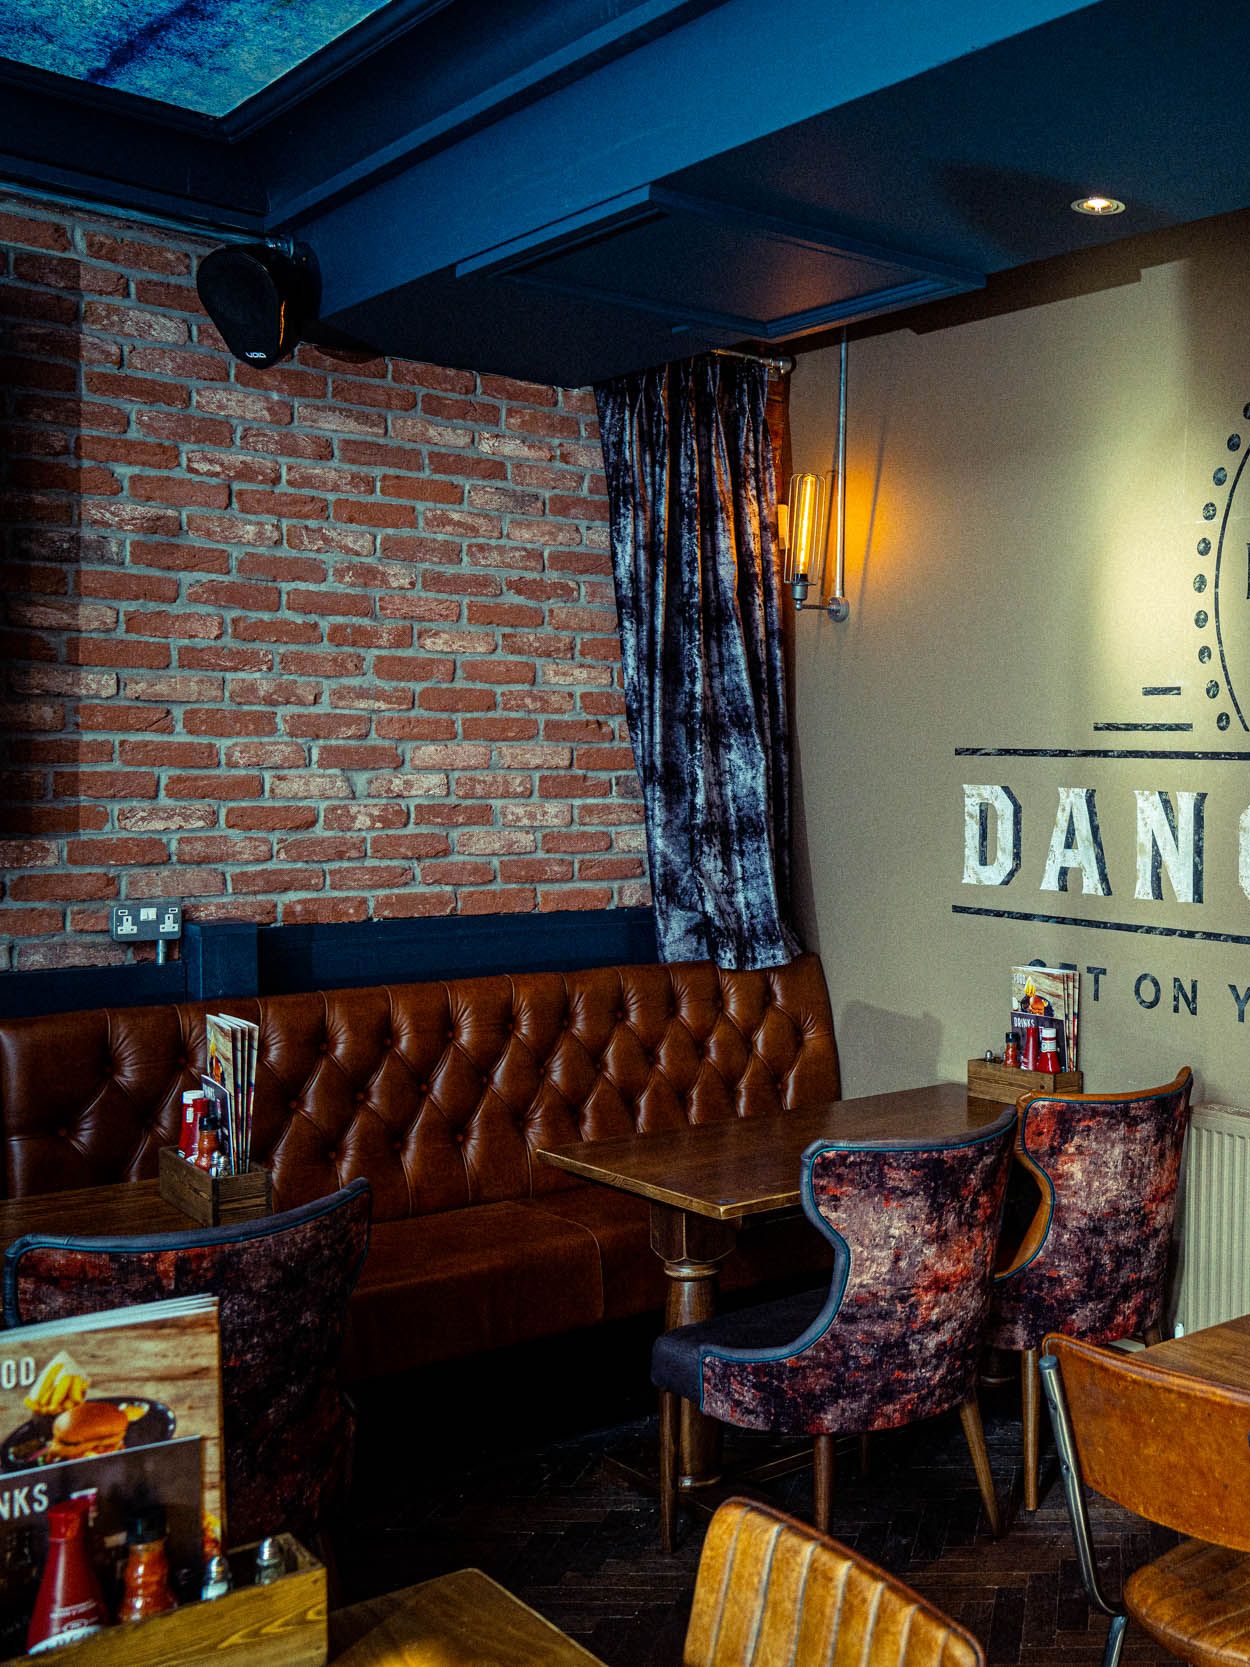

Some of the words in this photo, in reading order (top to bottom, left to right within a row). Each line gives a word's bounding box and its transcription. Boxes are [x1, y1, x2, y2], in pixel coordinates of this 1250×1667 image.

[1134, 973, 1199, 1016] ON
[0, 1356, 36, 1390] OD
[0, 1482, 49, 1521] NKS
